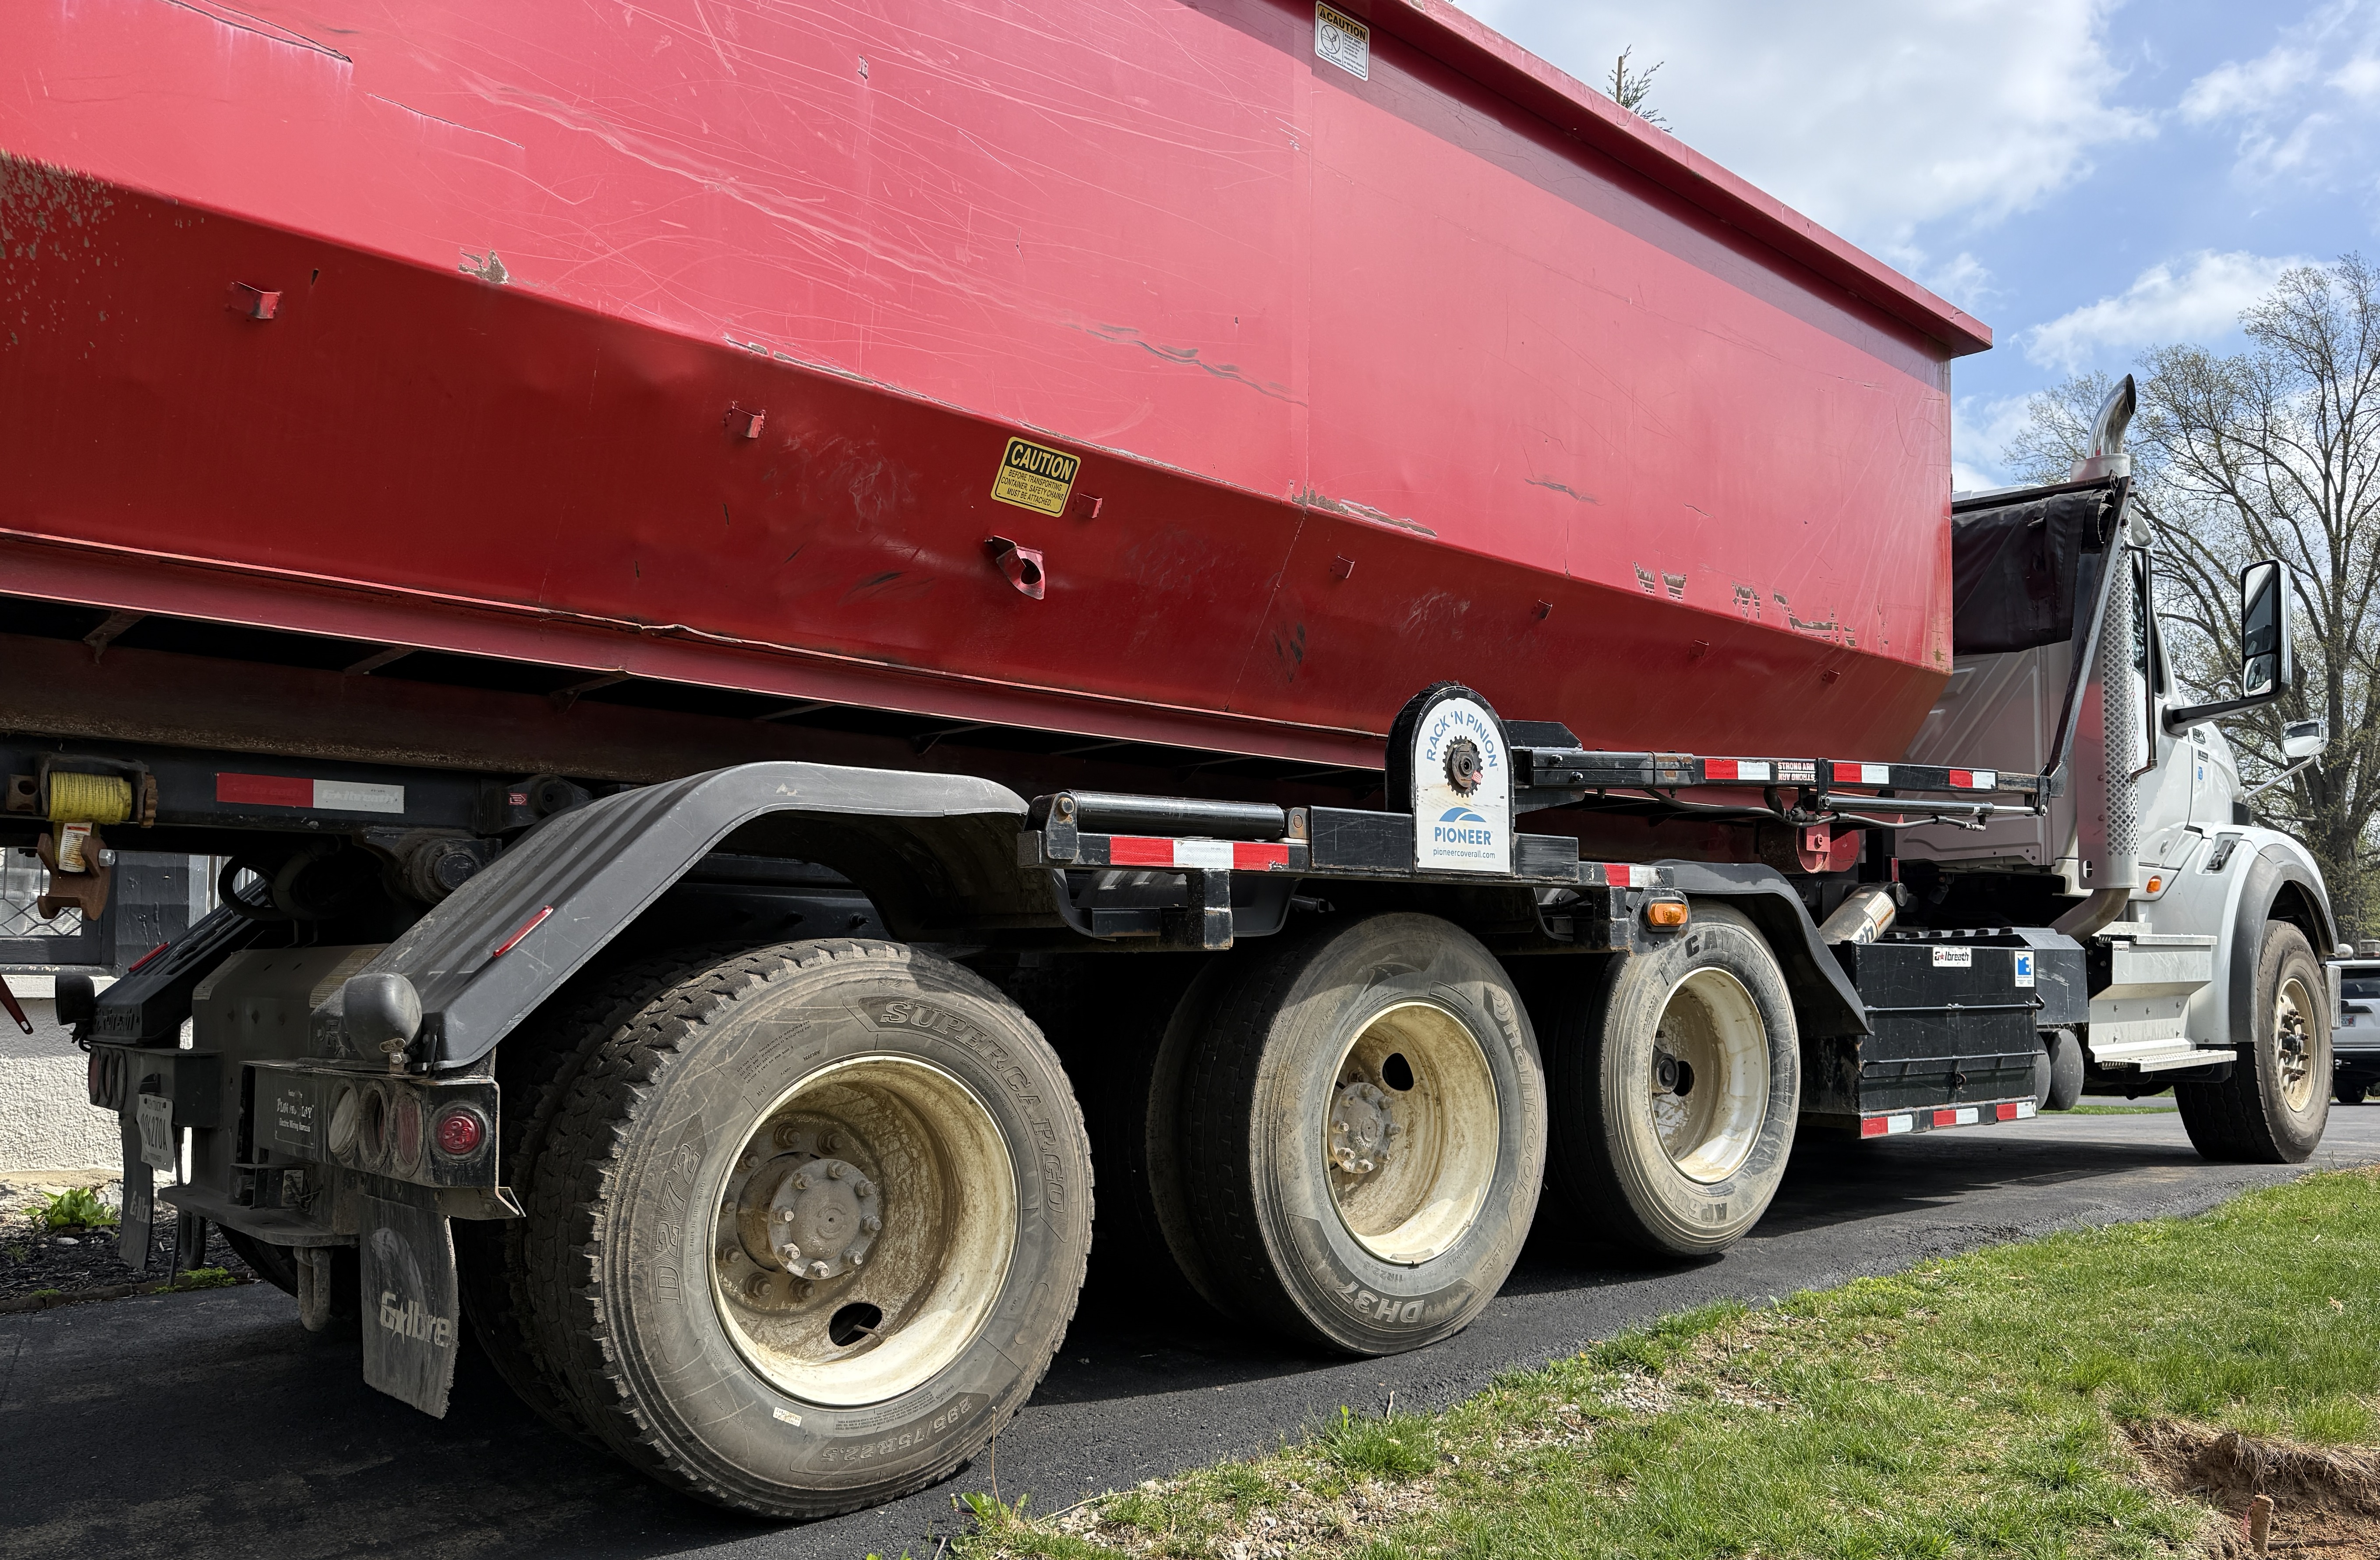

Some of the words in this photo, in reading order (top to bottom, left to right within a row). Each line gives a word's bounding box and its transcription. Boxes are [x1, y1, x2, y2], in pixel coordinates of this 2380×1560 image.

[1326, 13, 1366, 41] CAUTION
[1011, 444, 1074, 481] CAUTION
[1001, 477, 1028, 491] CONTAINER,
[1029, 485, 1047, 496] SAFETY
[1047, 489, 1064, 501] CHAINS
[1008, 470, 1027, 481] BEFORE
[1028, 475, 1062, 491] TRANSPORTING
[1007, 488, 1020, 497] MUST
[1027, 493, 1051, 507] ATTACHED.
[1426, 715, 1451, 762] RACK
[1466, 713, 1498, 768] PINION
[1777, 762, 1801, 770] STRONG
[1802, 763, 1815, 771] ARM
[1434, 826, 1492, 845] PIONEER
[1433, 847, 1496, 859] pioneercoverall.com
[880, 1001, 1065, 1213] SUPERCARGO
[657, 1143, 702, 1306] D272
[1336, 1280, 1425, 1323] DH37
[820, 1396, 972, 1462] 295/75R22.5
